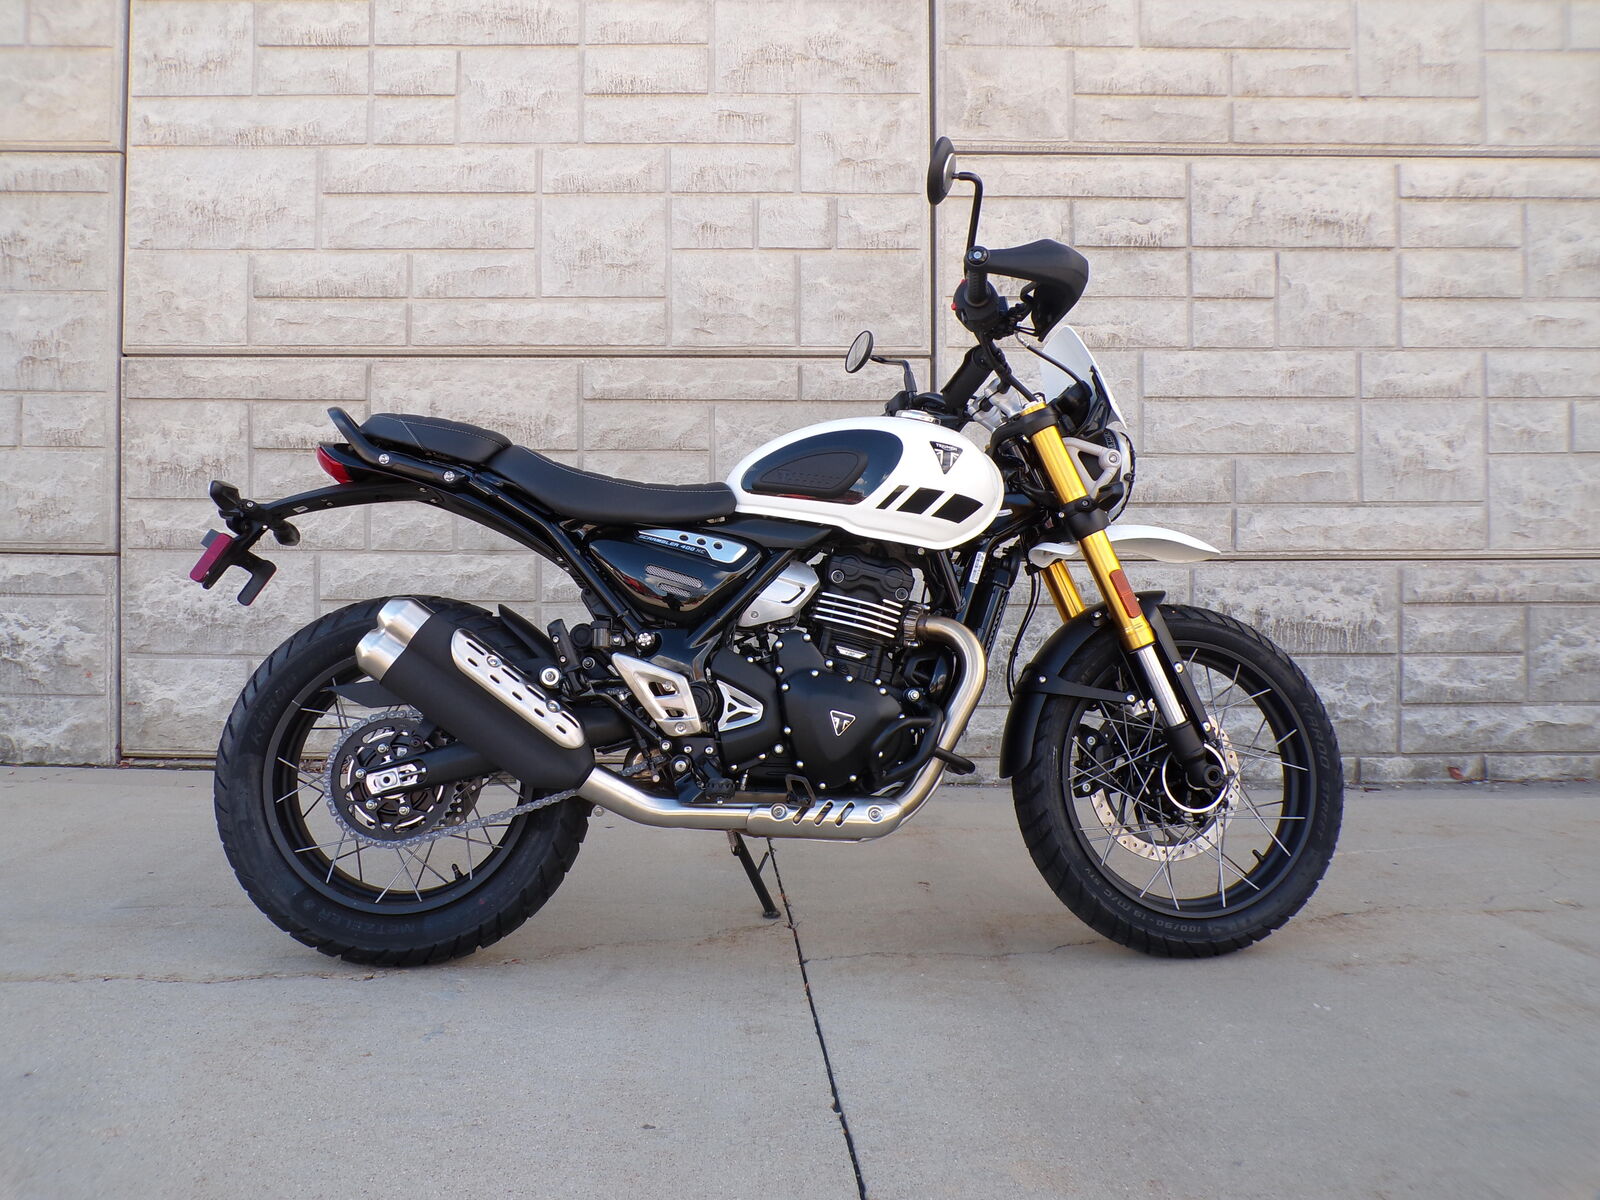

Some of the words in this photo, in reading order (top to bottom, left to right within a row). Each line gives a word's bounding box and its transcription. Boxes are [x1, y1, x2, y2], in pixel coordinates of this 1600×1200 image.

[935, 442, 958, 451] TRIUMPH
[638, 535, 680, 547] SCRAMBLER
[680, 544, 695, 552] 400
[1300, 702, 1330, 770] KAROO
[1155, 919, 1201, 933] 100/90
